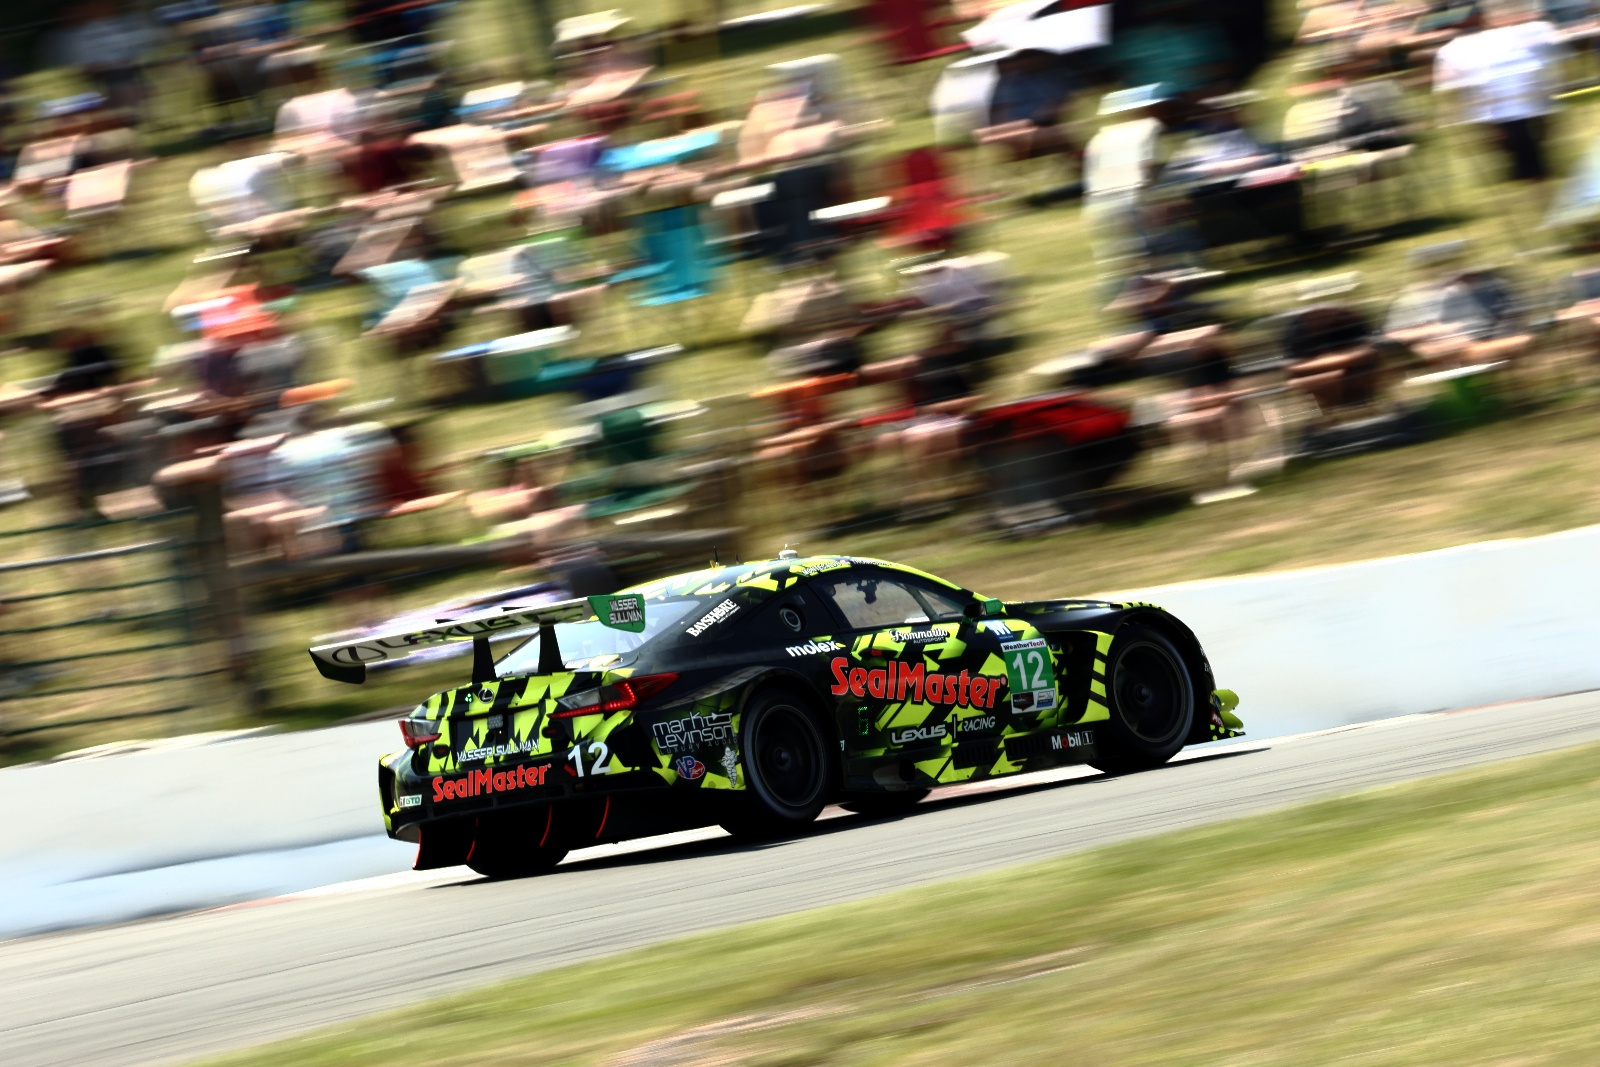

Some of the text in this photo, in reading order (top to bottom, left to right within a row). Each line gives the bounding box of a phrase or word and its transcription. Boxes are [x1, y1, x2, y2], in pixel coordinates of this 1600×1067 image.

[609, 597, 638, 611] VASSER
[609, 609, 643, 624] SULLIVAN
[686, 598, 737, 637] BAYSHORE
[785, 640, 841, 657] molex
[1003, 639, 1045, 651] WeatherTech
[830, 656, 1002, 708] SealMaster
[1012, 650, 1048, 690] 12
[652, 711, 704, 736] mark
[891, 715, 995, 744] LEXUS RACING
[457, 738, 540, 763] VASSER SULLIVAN
[1051, 732, 1081, 750] Mobil
[568, 741, 611, 778] 12
[676, 755, 695, 779] VP
[432, 764, 548, 802] SealMaster
